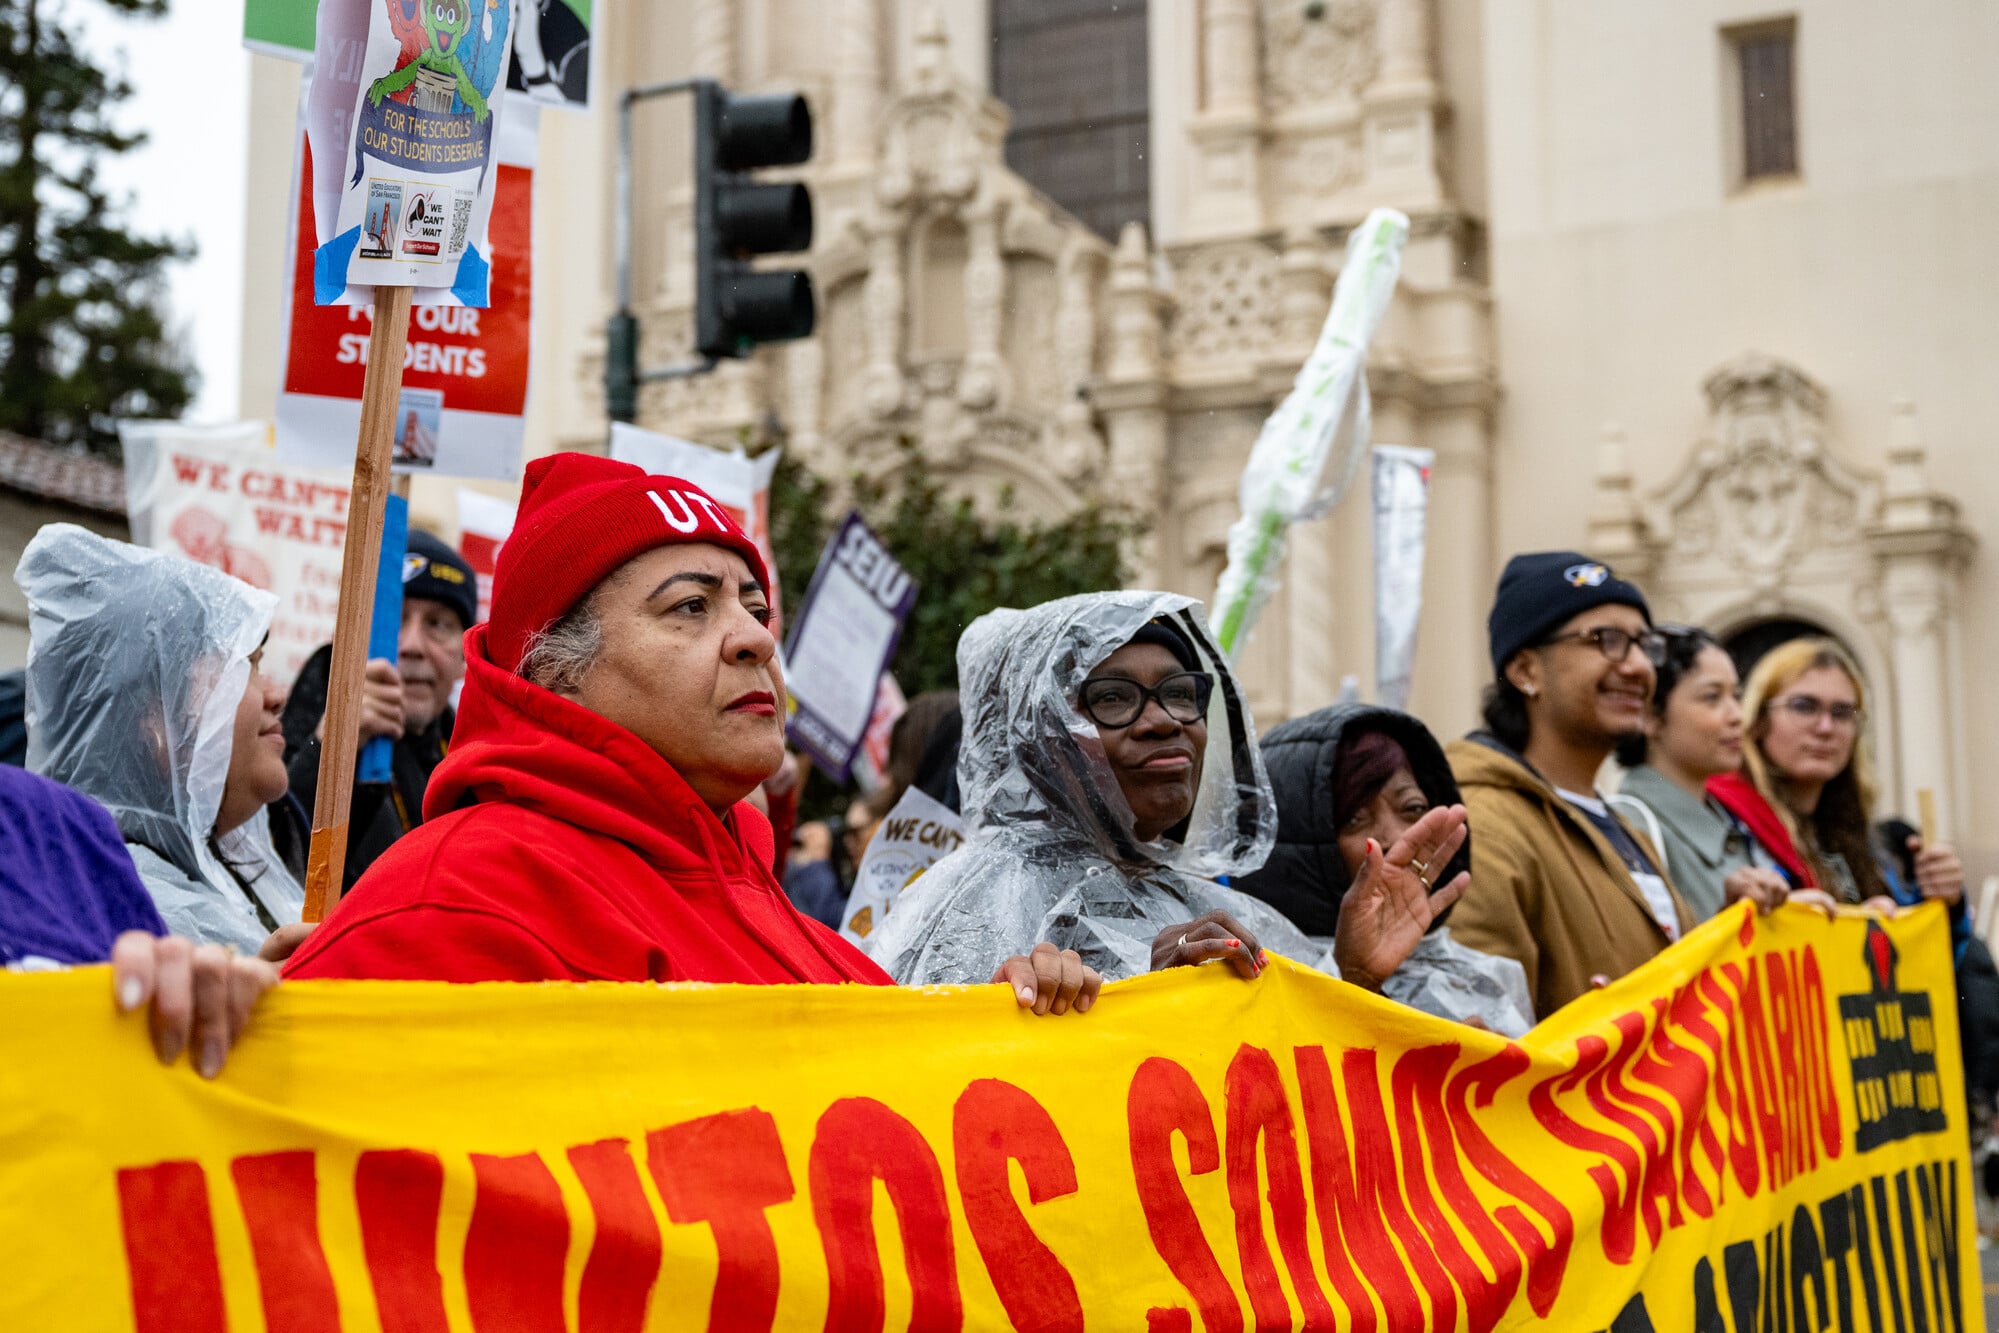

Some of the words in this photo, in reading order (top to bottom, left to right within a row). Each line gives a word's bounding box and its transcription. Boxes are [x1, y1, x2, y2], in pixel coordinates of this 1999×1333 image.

[384, 108, 406, 133] FOR
[408, 116, 427, 138] THE
[428, 119, 471, 139] SCHOOLS
[364, 127, 388, 152] OUR
[390, 136, 443, 163] STUDENTS
[444, 140, 484, 163] DESERVE
[430, 203, 443, 213] WE
[422, 227, 442, 238] WAIT
[416, 305, 480, 336] OUR
[336, 333, 486, 378] STDENTS
[172, 454, 229, 493] WE
[836, 522, 911, 609] SEIU
[885, 817, 920, 842] WE
[1127, 1041, 1575, 1333] SOMOS
